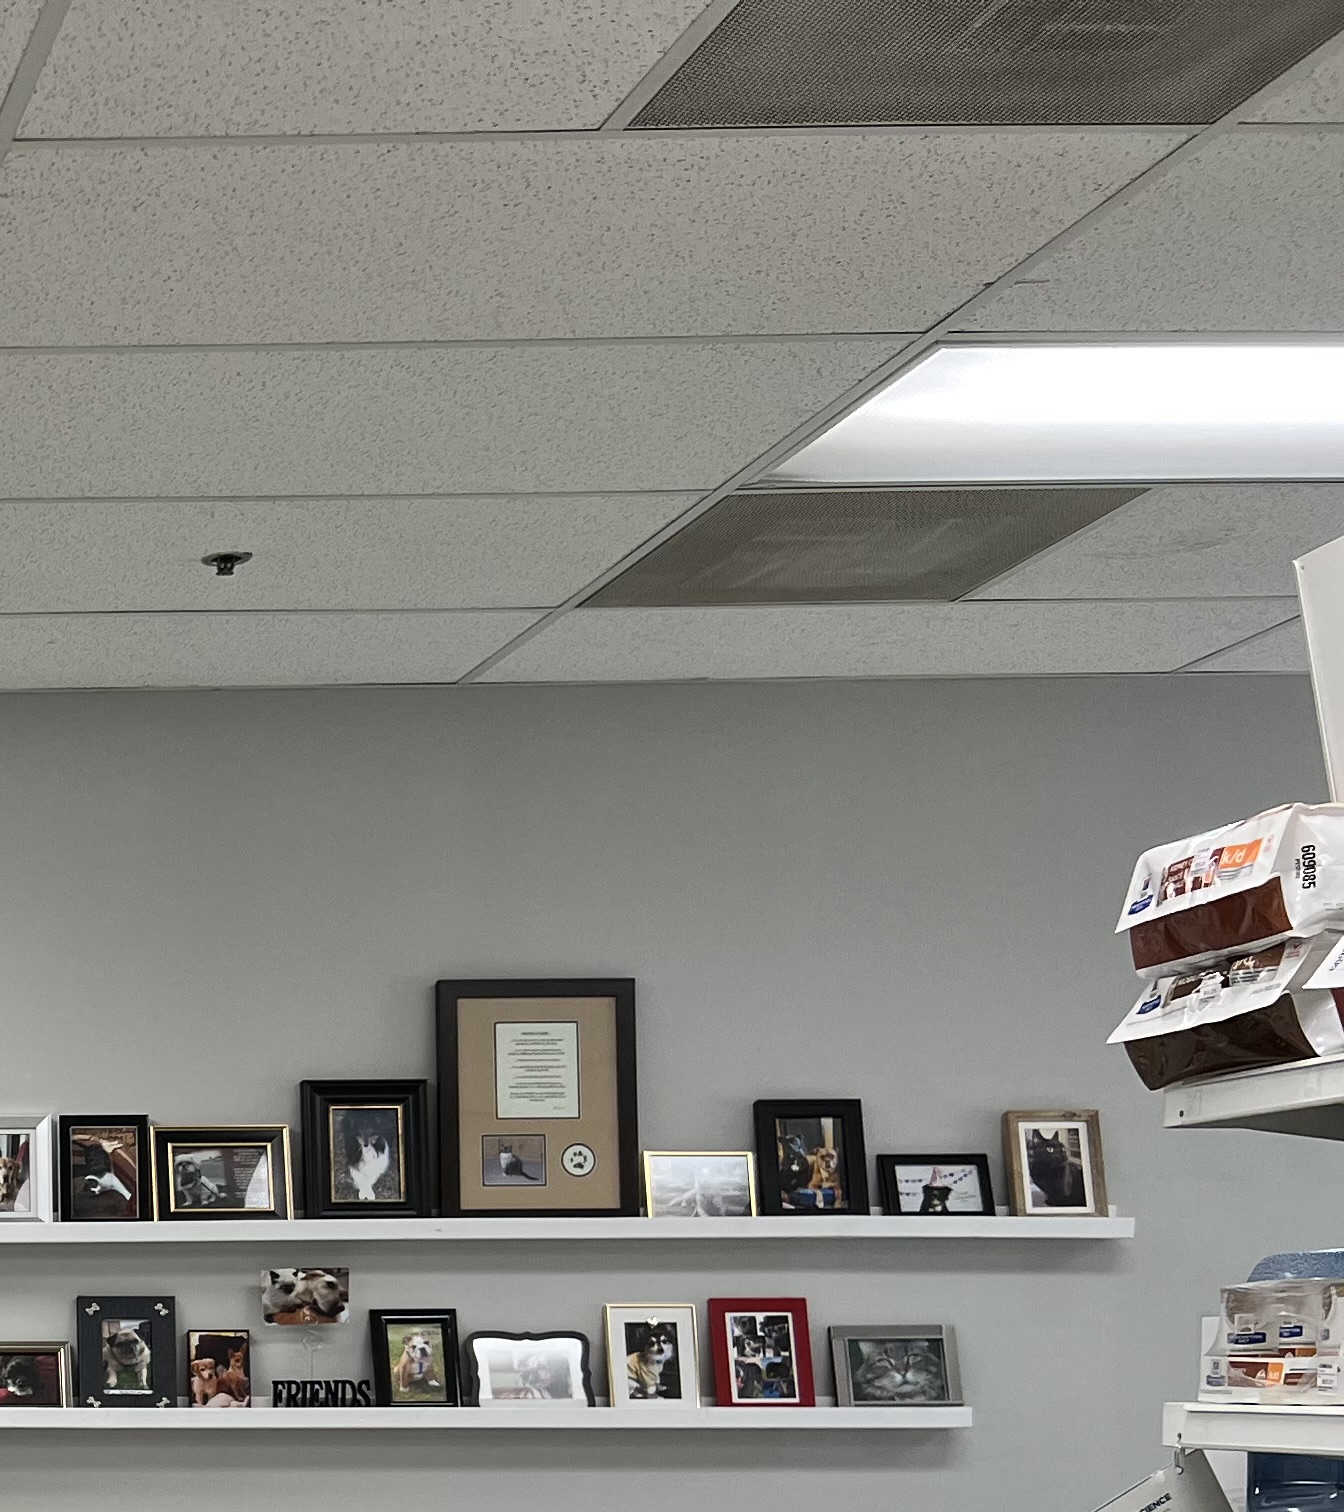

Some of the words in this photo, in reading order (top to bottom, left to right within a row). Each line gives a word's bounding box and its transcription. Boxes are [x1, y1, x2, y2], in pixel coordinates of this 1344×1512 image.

[1221, 849, 1247, 866] k/d
[1300, 844, 1317, 890] 609085
[271, 1379, 372, 1409] FRIENDS
